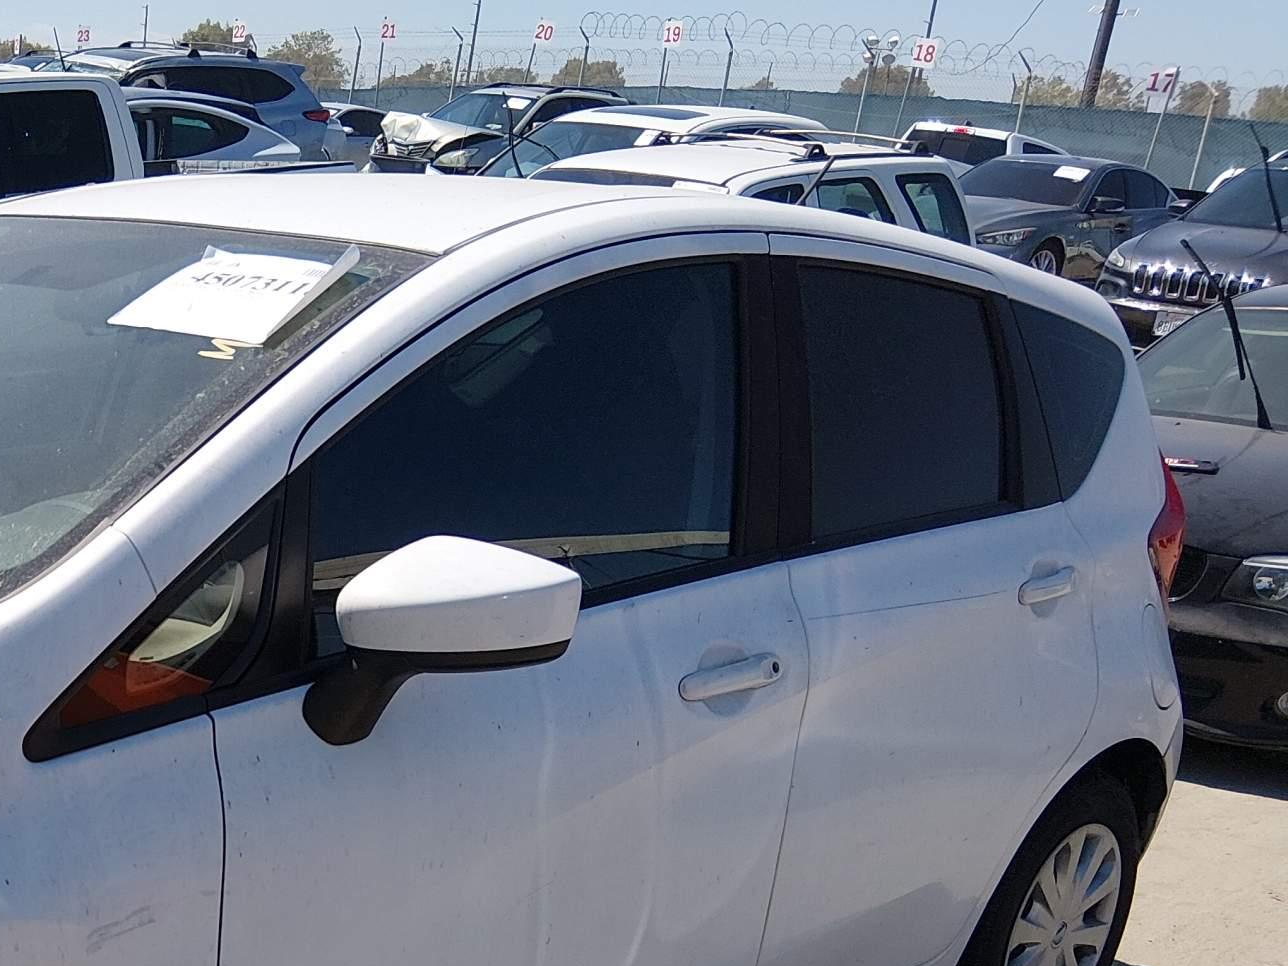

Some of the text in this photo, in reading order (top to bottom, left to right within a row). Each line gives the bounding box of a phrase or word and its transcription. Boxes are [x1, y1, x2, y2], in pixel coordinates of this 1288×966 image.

[77, 30, 90, 42] 23
[233, 25, 246, 39] 22
[381, 24, 396, 38] 21
[535, 24, 553, 41] 20
[664, 26, 681, 43] 19
[913, 44, 936, 63] 18
[1145, 72, 1175, 93] 17
[191, 271, 312, 296] 4507311
